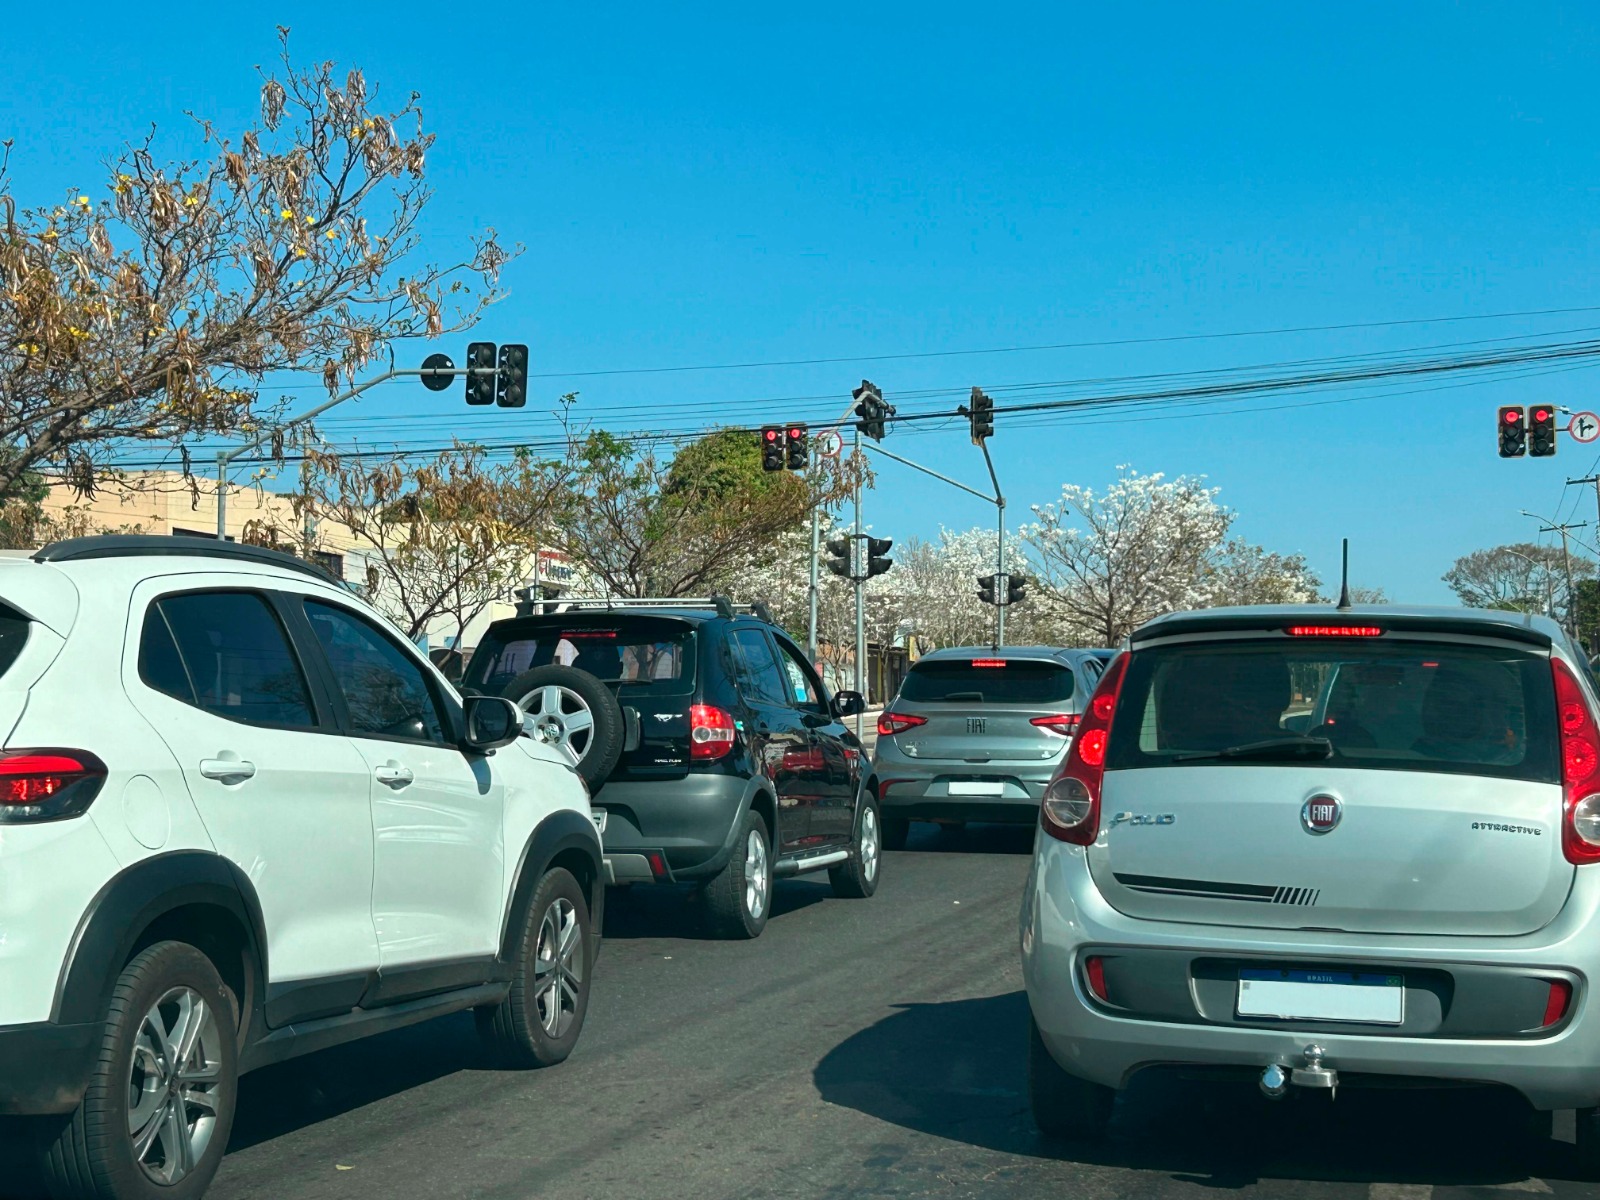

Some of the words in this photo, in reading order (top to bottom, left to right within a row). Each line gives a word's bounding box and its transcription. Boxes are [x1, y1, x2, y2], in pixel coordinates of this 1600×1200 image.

[966, 716, 987, 734] FIAT
[1312, 804, 1335, 822] FIAT
[1471, 821, 1542, 836] ATTRACTIVE
